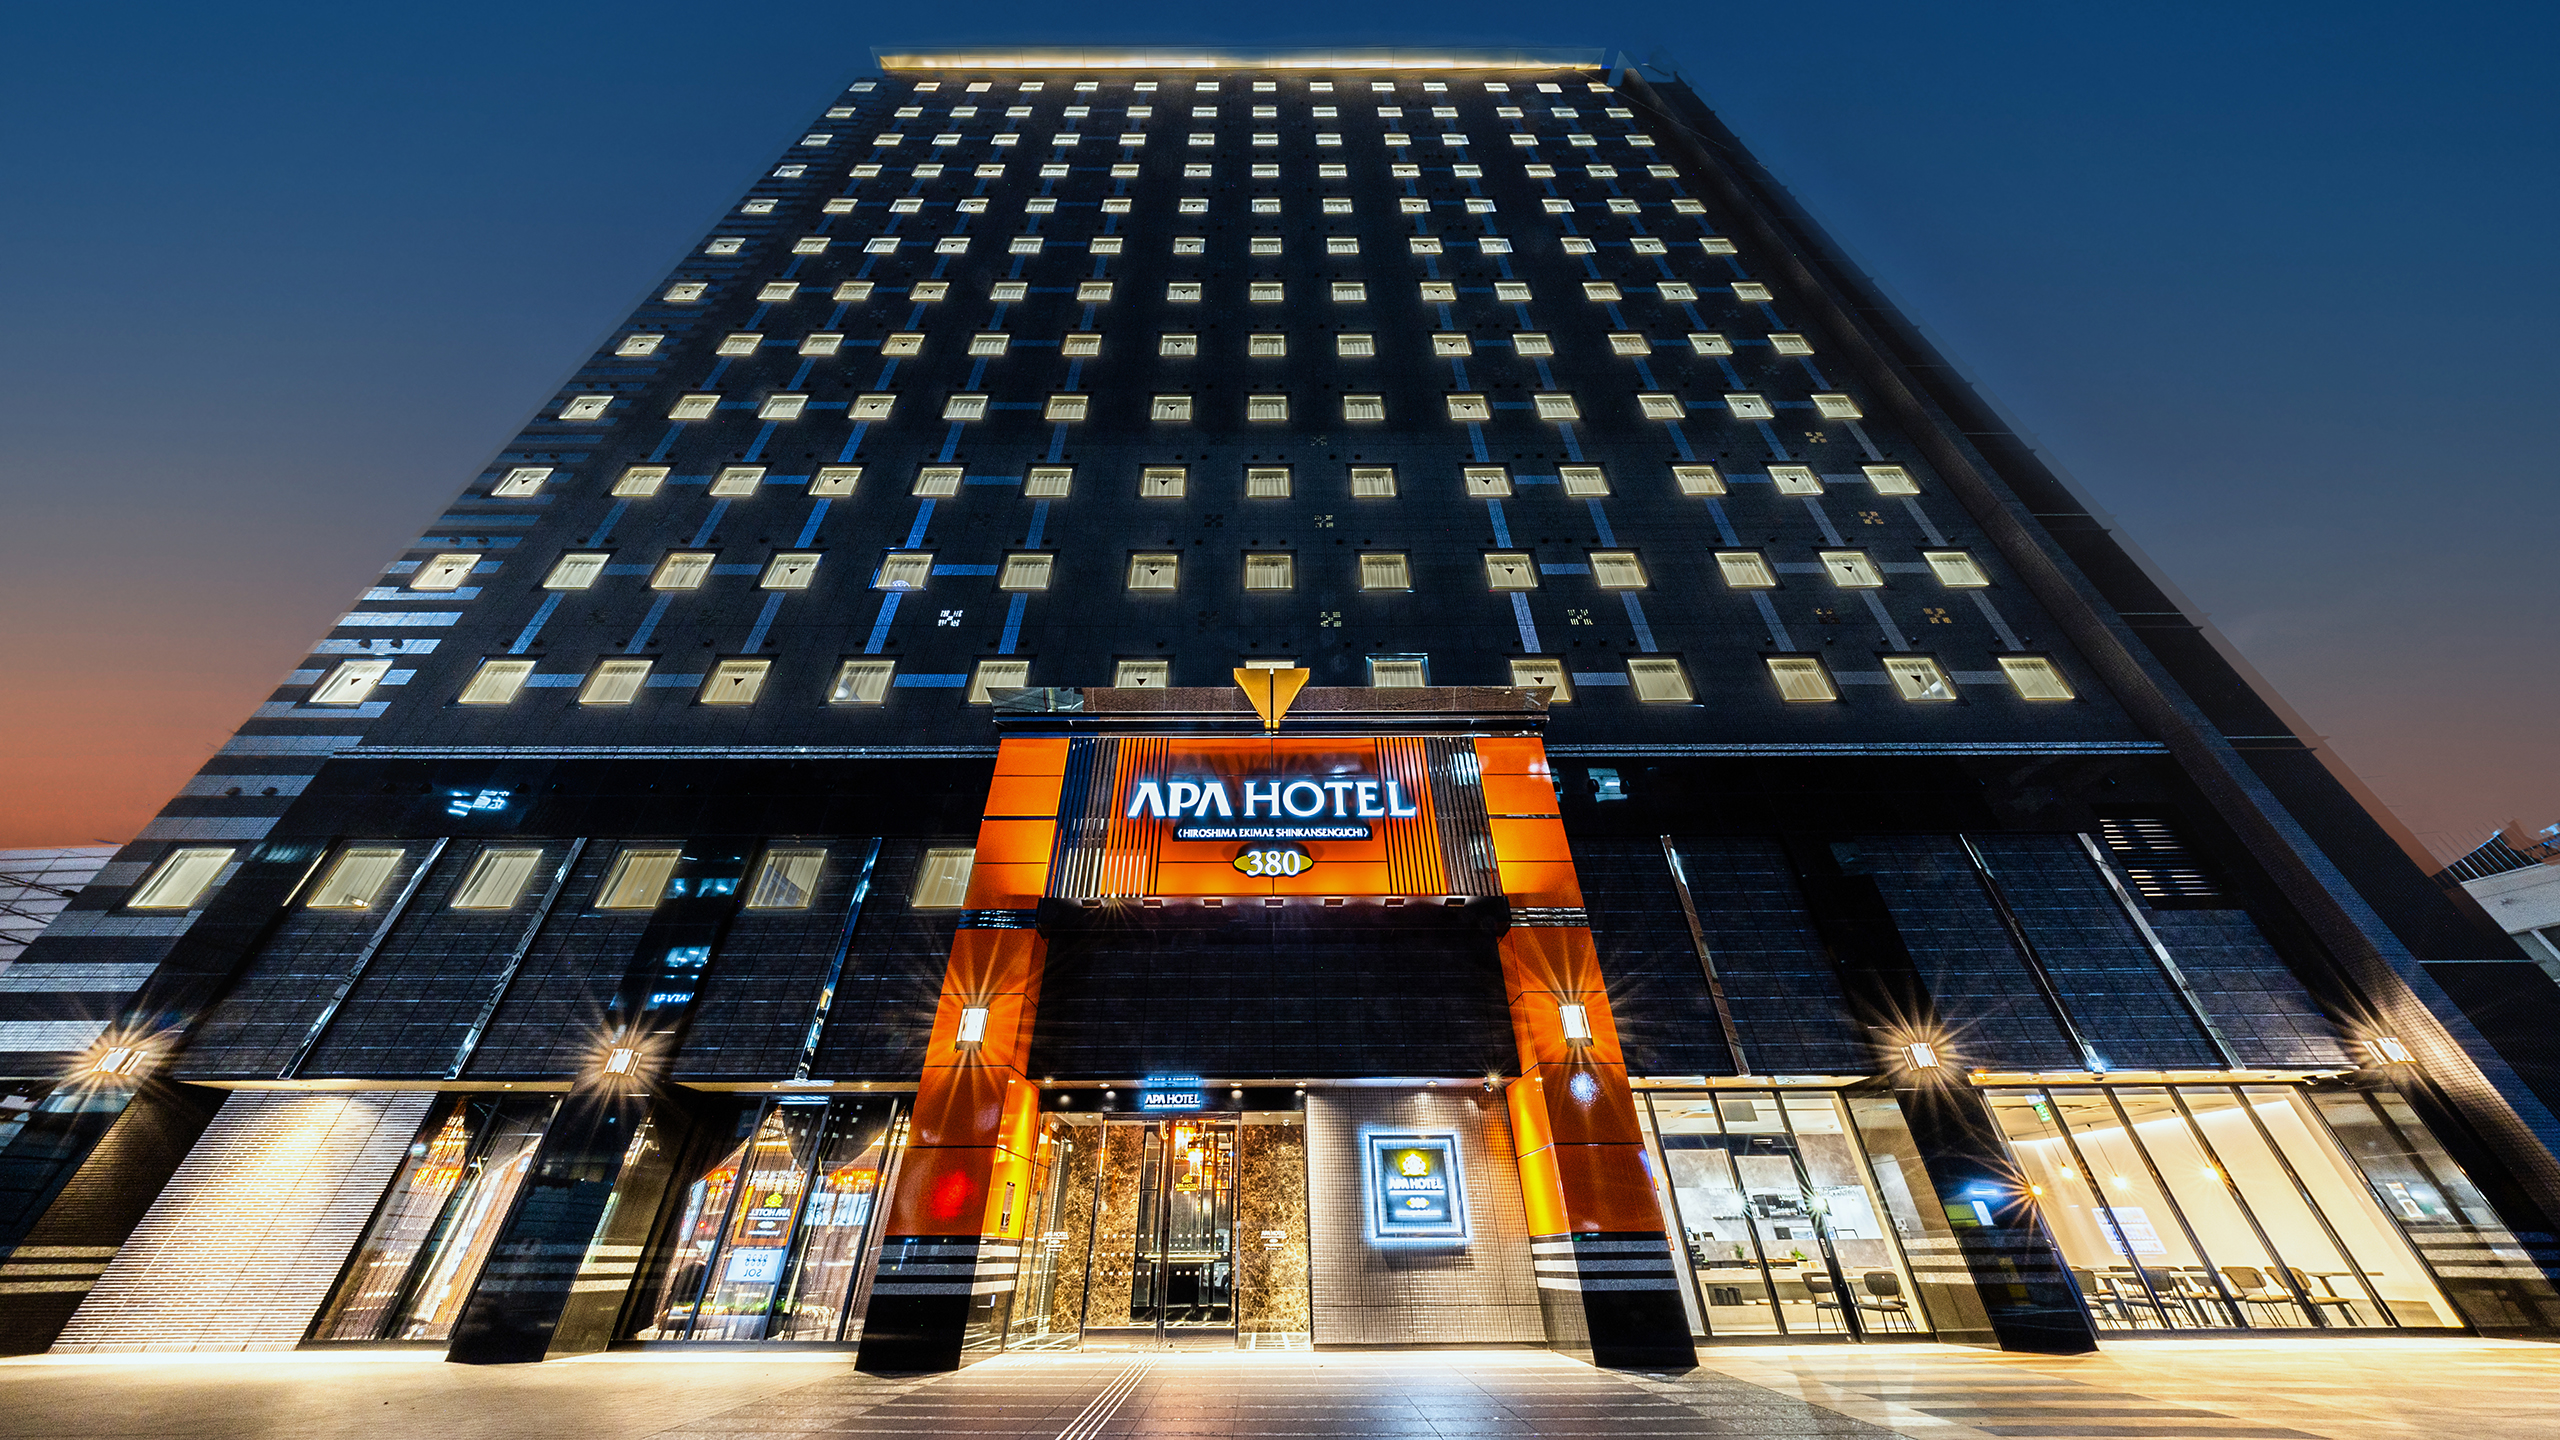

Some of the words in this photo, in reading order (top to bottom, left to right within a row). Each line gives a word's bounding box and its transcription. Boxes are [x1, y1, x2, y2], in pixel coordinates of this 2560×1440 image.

[1127, 782, 1233, 817] APA
[1243, 781, 1417, 817] HOTEL
[1239, 828, 1275, 837] EKIMAE
[1246, 850, 1301, 876] 380
[1145, 1094, 1166, 1104] APA
[1166, 1094, 1201, 1104] HOTEL
[1410, 1178, 1444, 1190] HOTEL
